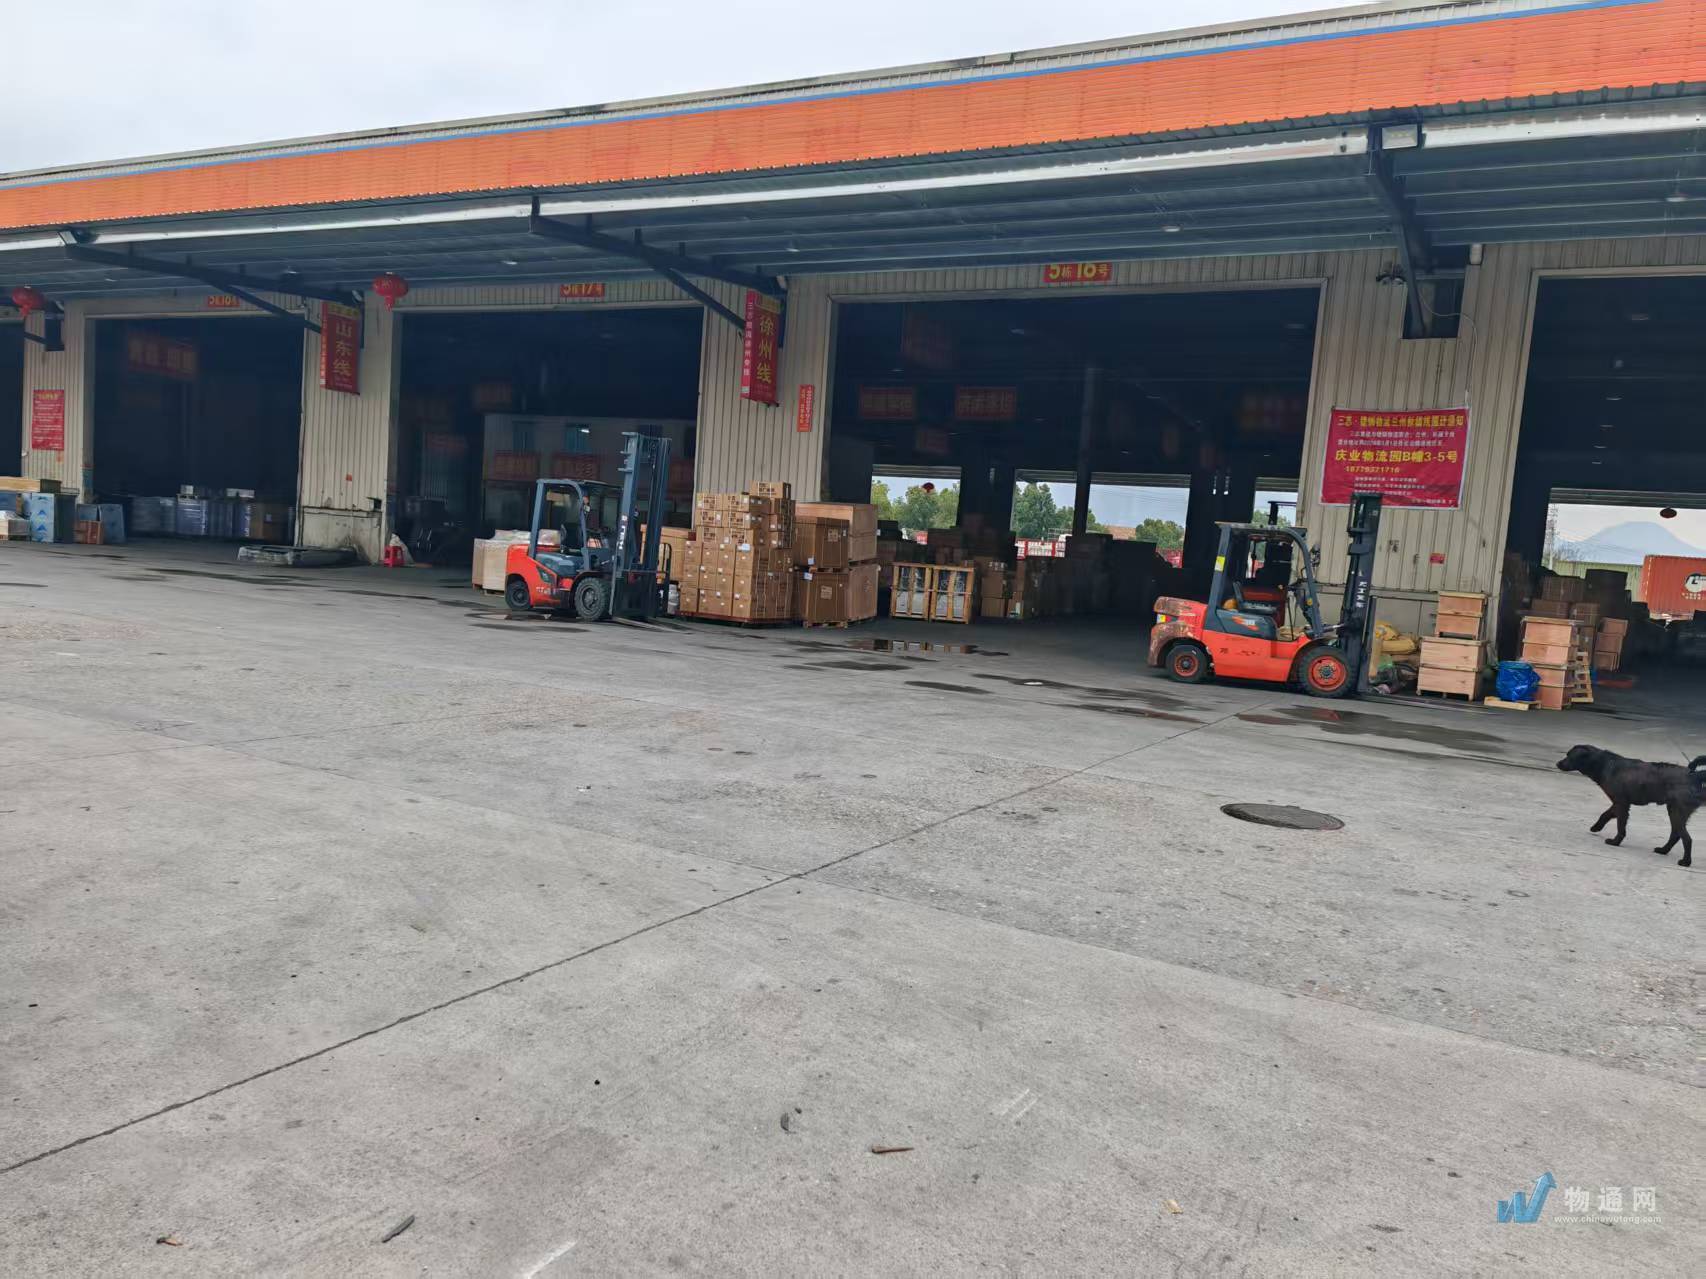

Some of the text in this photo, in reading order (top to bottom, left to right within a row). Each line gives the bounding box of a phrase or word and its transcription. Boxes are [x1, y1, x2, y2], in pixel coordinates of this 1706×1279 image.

[334, 322, 353, 376] 山东线
[756, 314, 774, 384] 徐州线
